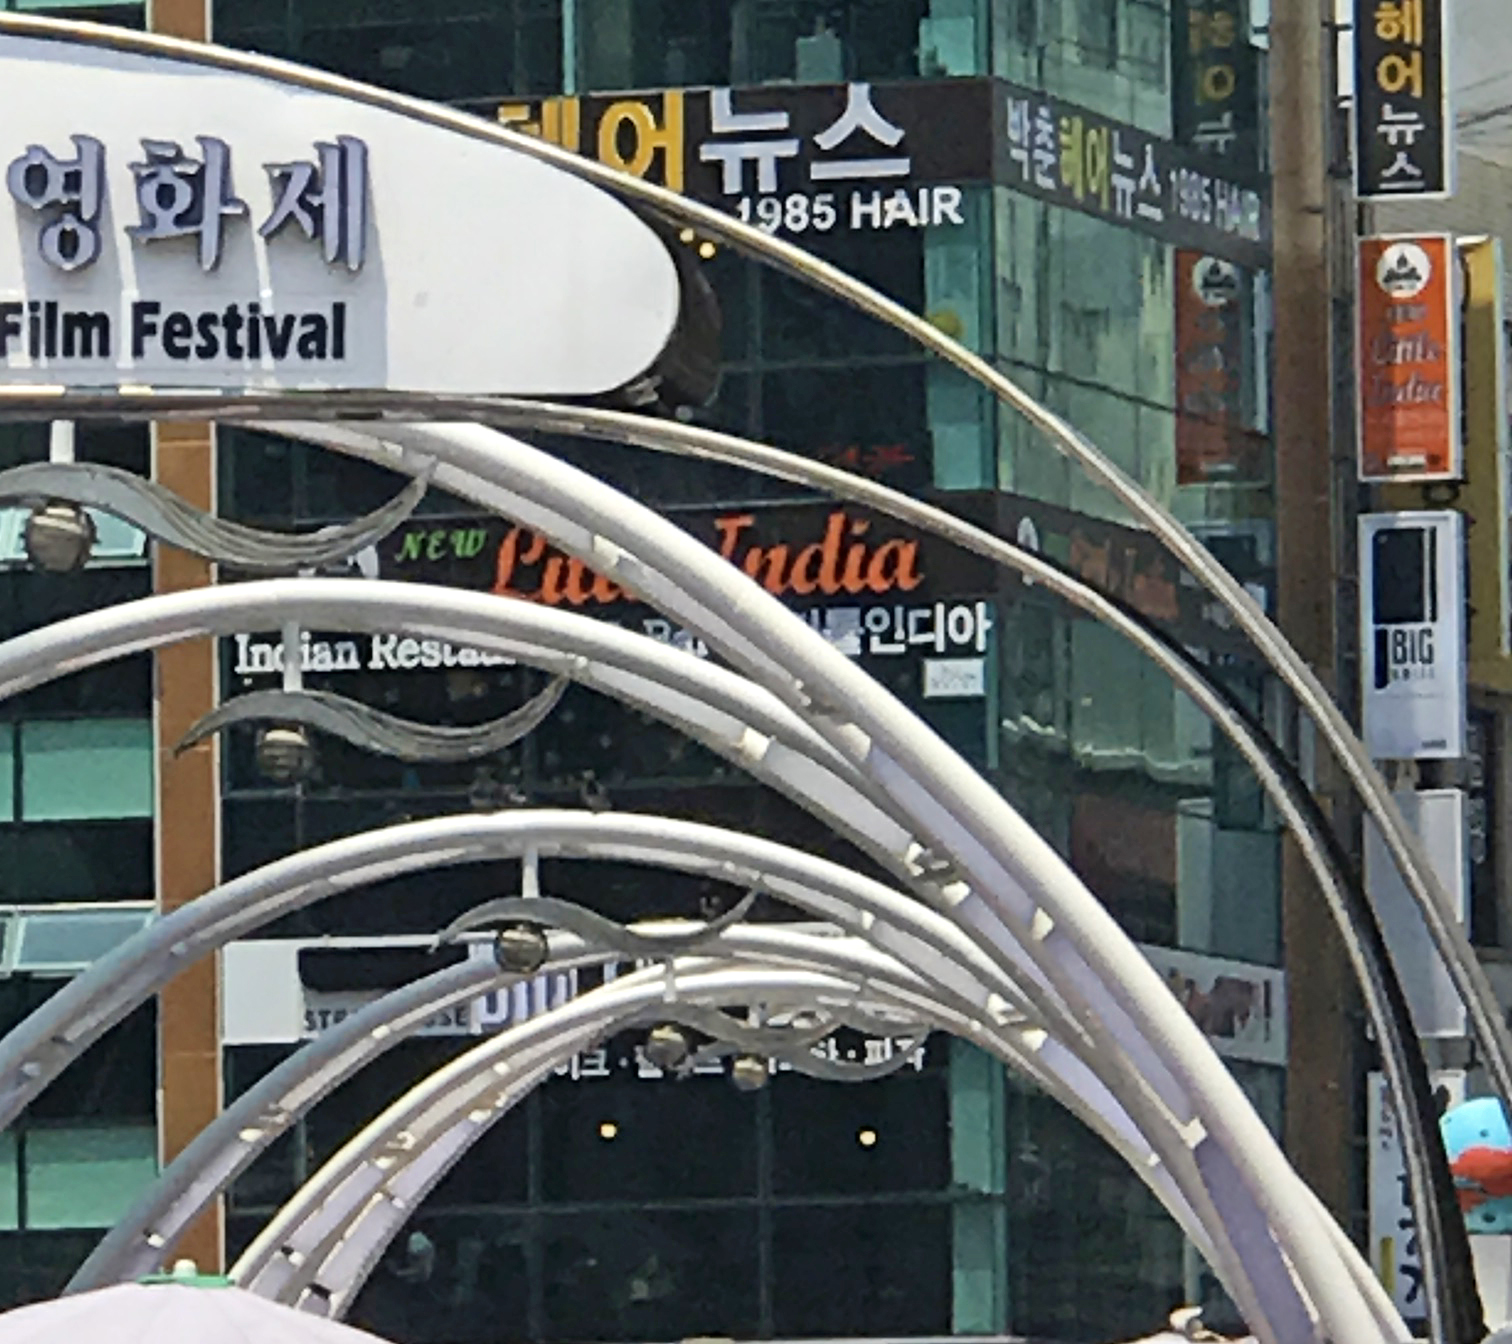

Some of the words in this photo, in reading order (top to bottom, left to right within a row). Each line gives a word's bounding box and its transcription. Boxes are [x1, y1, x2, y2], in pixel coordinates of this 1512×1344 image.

[7, 132, 370, 273] 영화제
[735, 192, 837, 234] 1985
[851, 186, 964, 230] HAIR
[131, 298, 346, 360] Festival
[395, 529, 487, 562] NEW
[714, 512, 924, 597] India
[1392, 630, 1433, 665] BIG
